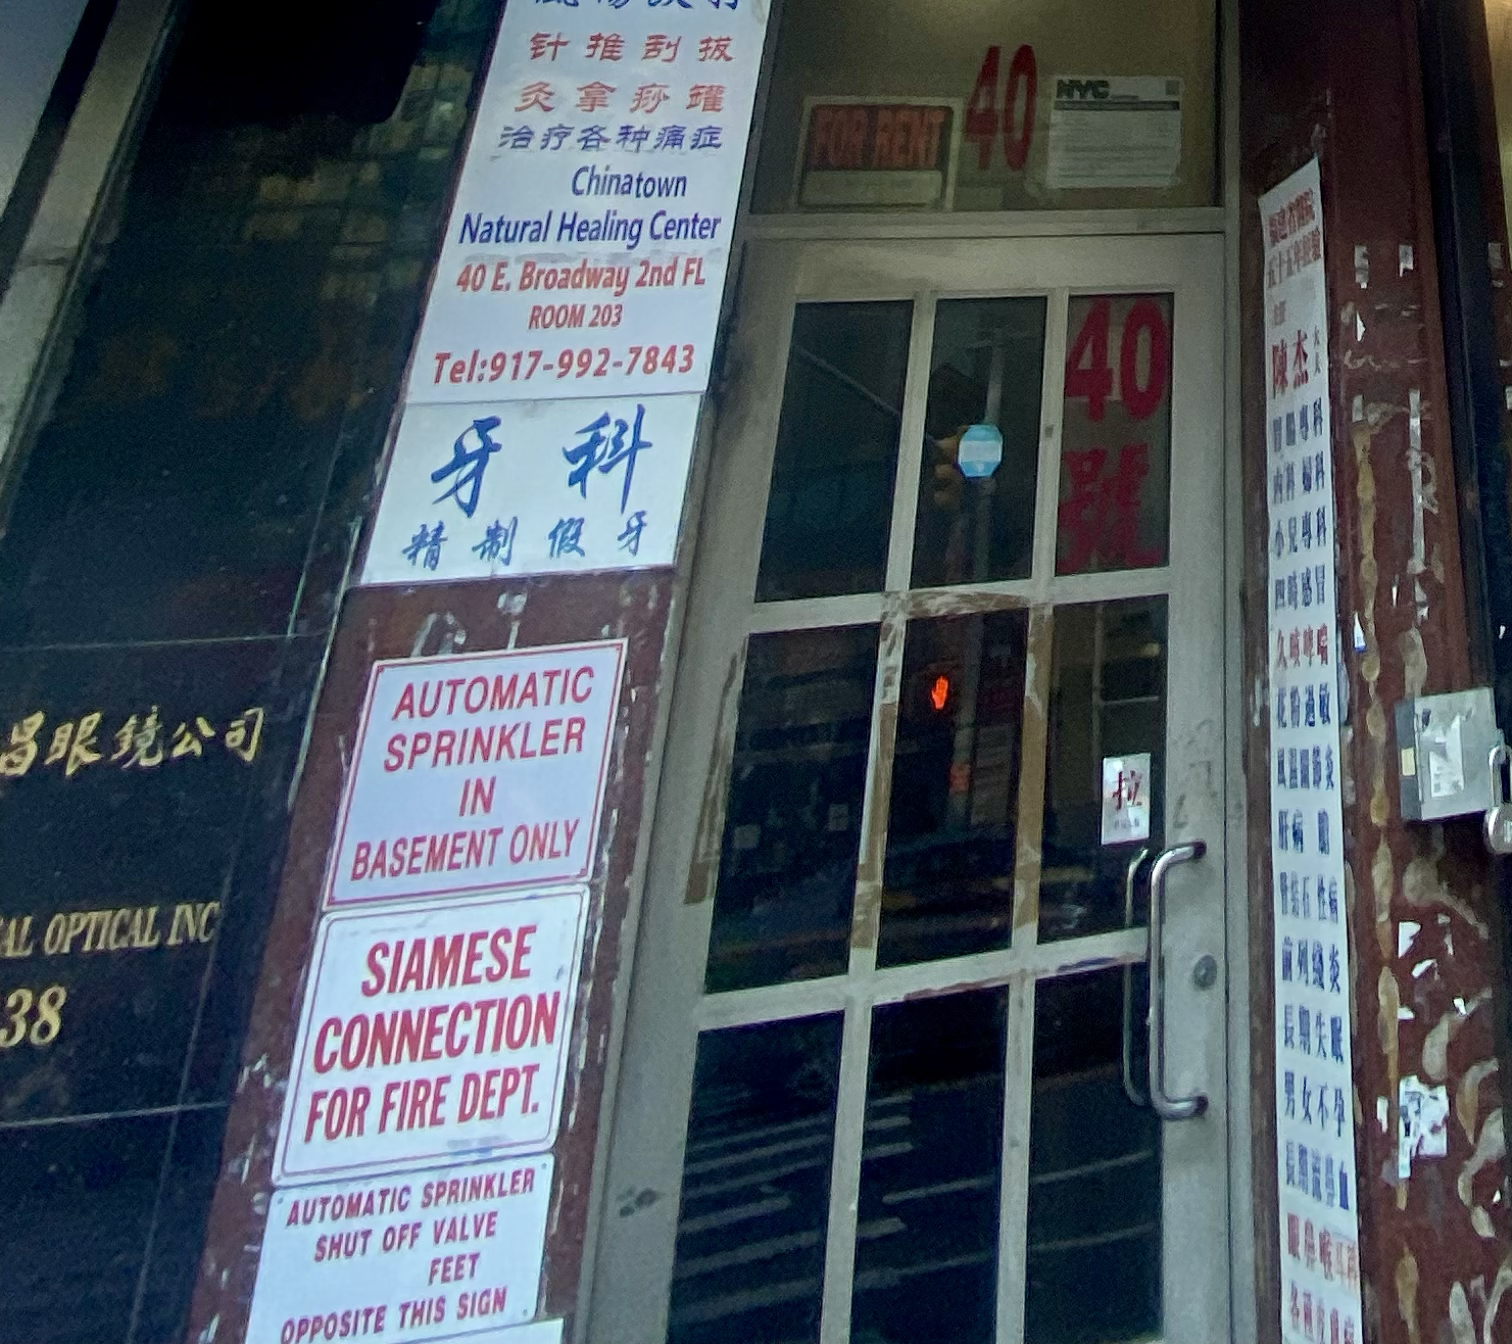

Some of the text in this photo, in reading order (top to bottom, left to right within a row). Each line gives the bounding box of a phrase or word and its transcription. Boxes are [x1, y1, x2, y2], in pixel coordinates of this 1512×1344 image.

[965, 44, 1038, 172] 40
[1056, 79, 1110, 99] NYC
[498, 123, 724, 153] 治疗各种痛症
[571, 165, 687, 199] Chinatown
[458, 210, 722, 250] Natural Healing Center
[456, 256, 706, 297] 40 E. Broadway 2nd FL
[528, 304, 623, 330] ROOM 203
[433, 343, 695, 385] Tel:917-992-7843
[1064, 297, 1168, 423] 40
[431, 403, 653, 518] 牙科
[401, 511, 648, 571] 精制假牙
[391, 665, 595, 720] AUTOMATIC
[382, 716, 588, 774] SPRINKLER
[458, 776, 497, 817] IN
[349, 818, 580, 883] BASEMENT ONLY
[44, 906, 161, 956] OPTICAL
[166, 901, 220, 949] INC
[361, 925, 538, 998] SIAMESE
[0, 984, 67, 1049] 38
[312, 991, 560, 1076] CONNECTION
[304, 1063, 540, 1144] FOR FIRE DEPT.
[285, 1167, 536, 1229] AUTOMATIC SPRINKLER
[313, 1210, 499, 1263] SHUT OFF VALVE
[427, 1251, 481, 1287] FEET
[280, 1285, 509, 1344] OPPOSITE THIS SIGN
